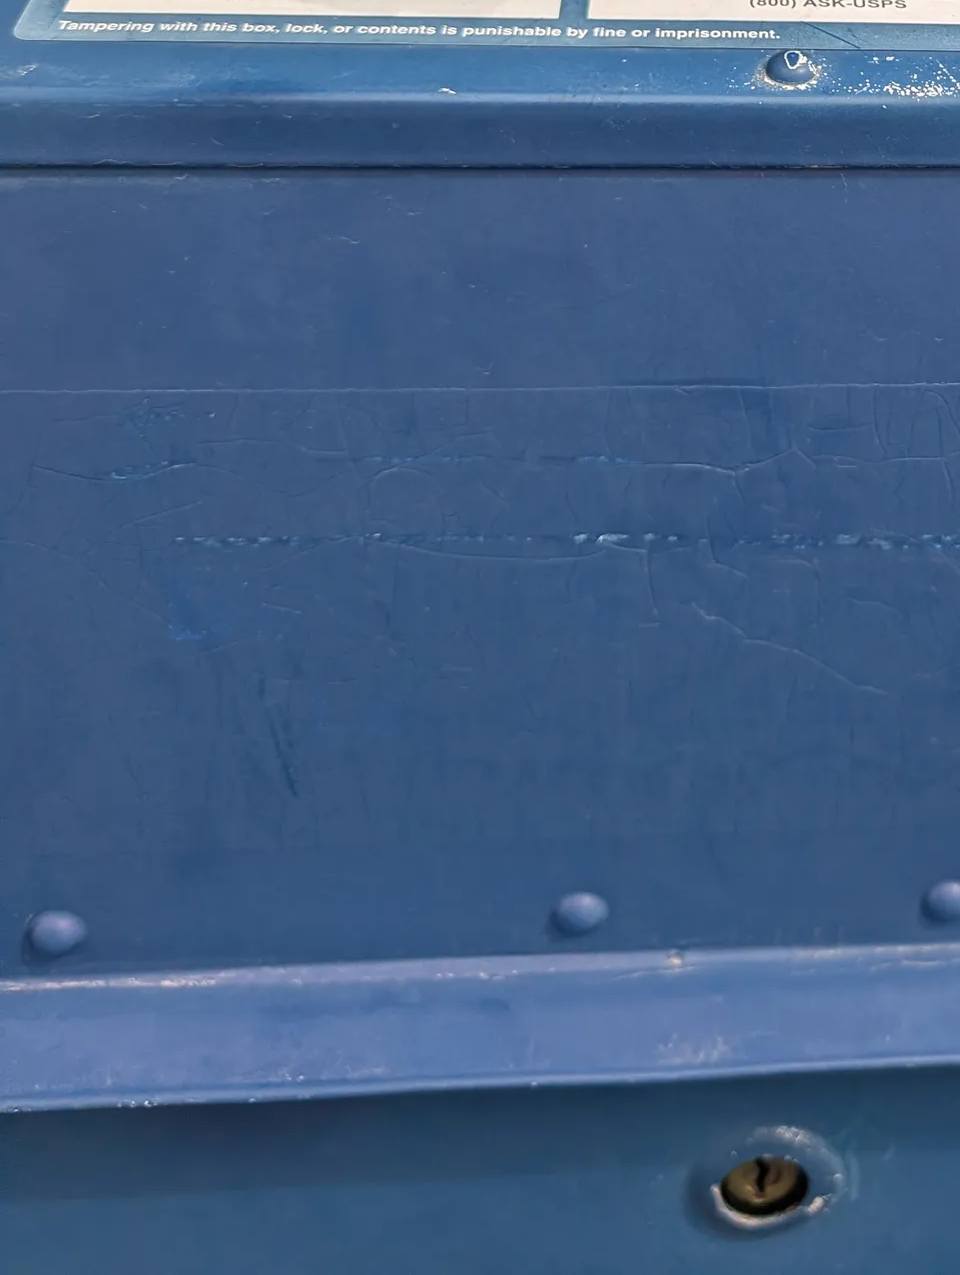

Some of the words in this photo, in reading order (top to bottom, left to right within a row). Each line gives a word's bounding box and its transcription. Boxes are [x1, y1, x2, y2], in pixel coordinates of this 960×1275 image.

[58, 19, 154, 33] Tampering
[160, 20, 198, 32] with
[203, 21, 237, 33] this
[242, 22, 280, 34] box,
[285, 23, 328, 35] lock,
[333, 24, 353, 35] or
[357, 24, 436, 35] contents
[442, 24, 458, 36] is
[462, 26, 561, 37] punishable
[567, 27, 589, 40] by
[593, 27, 627, 38] fine
[631, 28, 651, 38] or
[655, 28, 781, 40] imprisonment.
